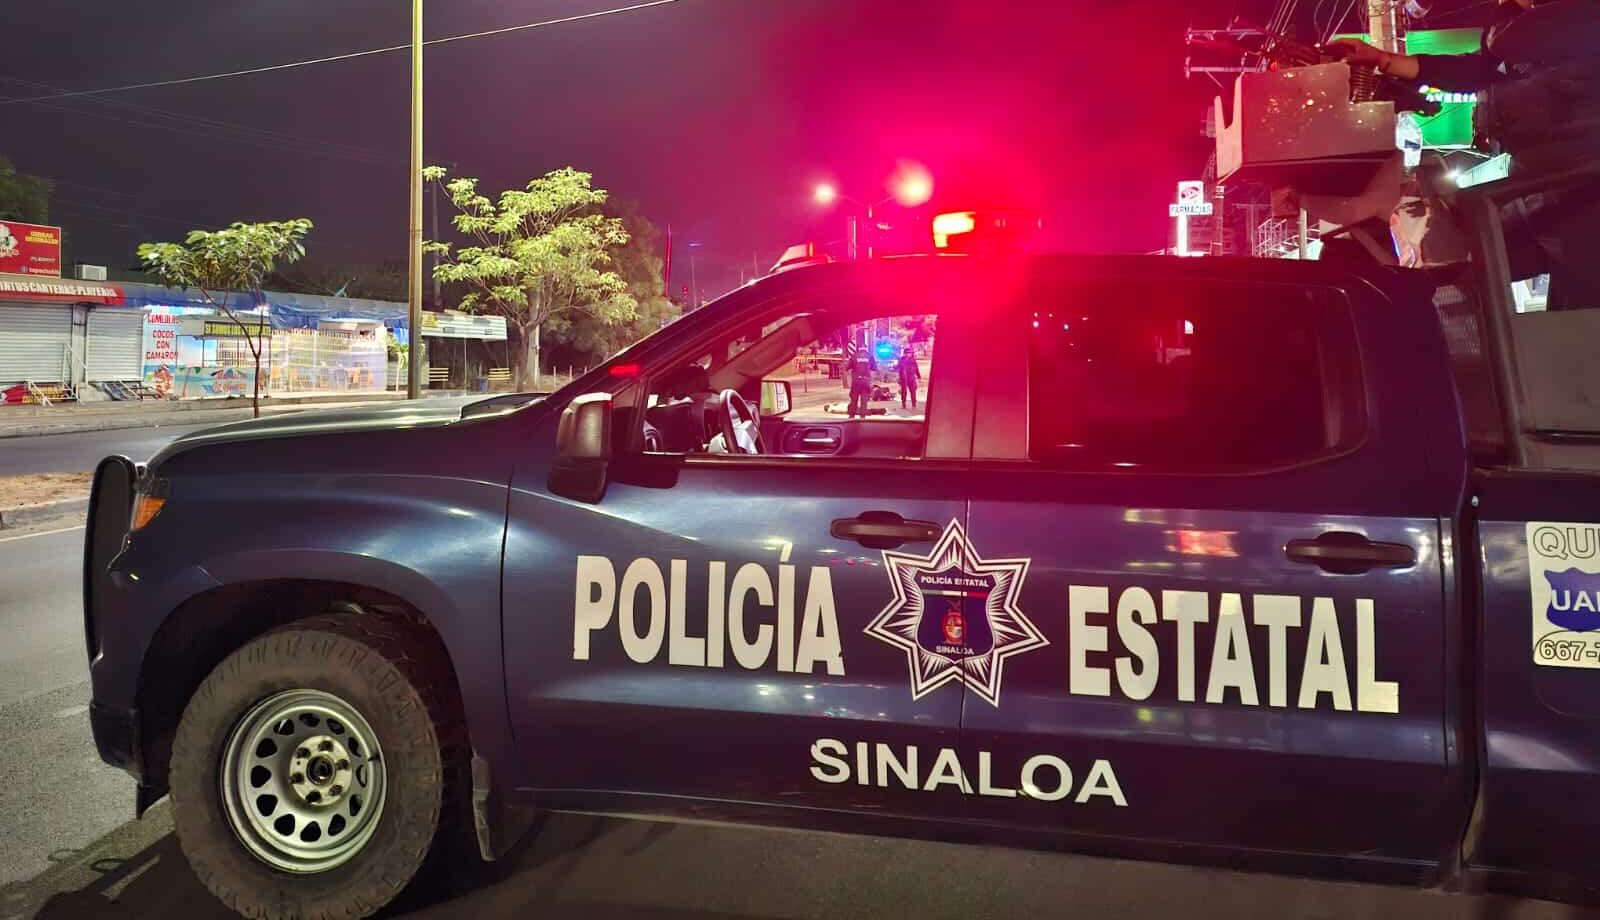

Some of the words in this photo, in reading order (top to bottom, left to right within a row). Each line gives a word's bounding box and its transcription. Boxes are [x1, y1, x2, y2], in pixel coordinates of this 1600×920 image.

[1171, 205, 1211, 213] FARMACIAS
[153, 330, 175, 338] COCOS
[156, 340, 170, 349] CON
[1533, 526, 1600, 561] QU
[921, 575, 952, 585] POLICÍA
[955, 579, 988, 588] ESTATAL
[573, 542, 846, 676] POLICÍA
[1069, 584, 1399, 714] ESTATAL
[936, 645, 974, 655] SINALOA
[809, 738, 1129, 807] SINALOA
